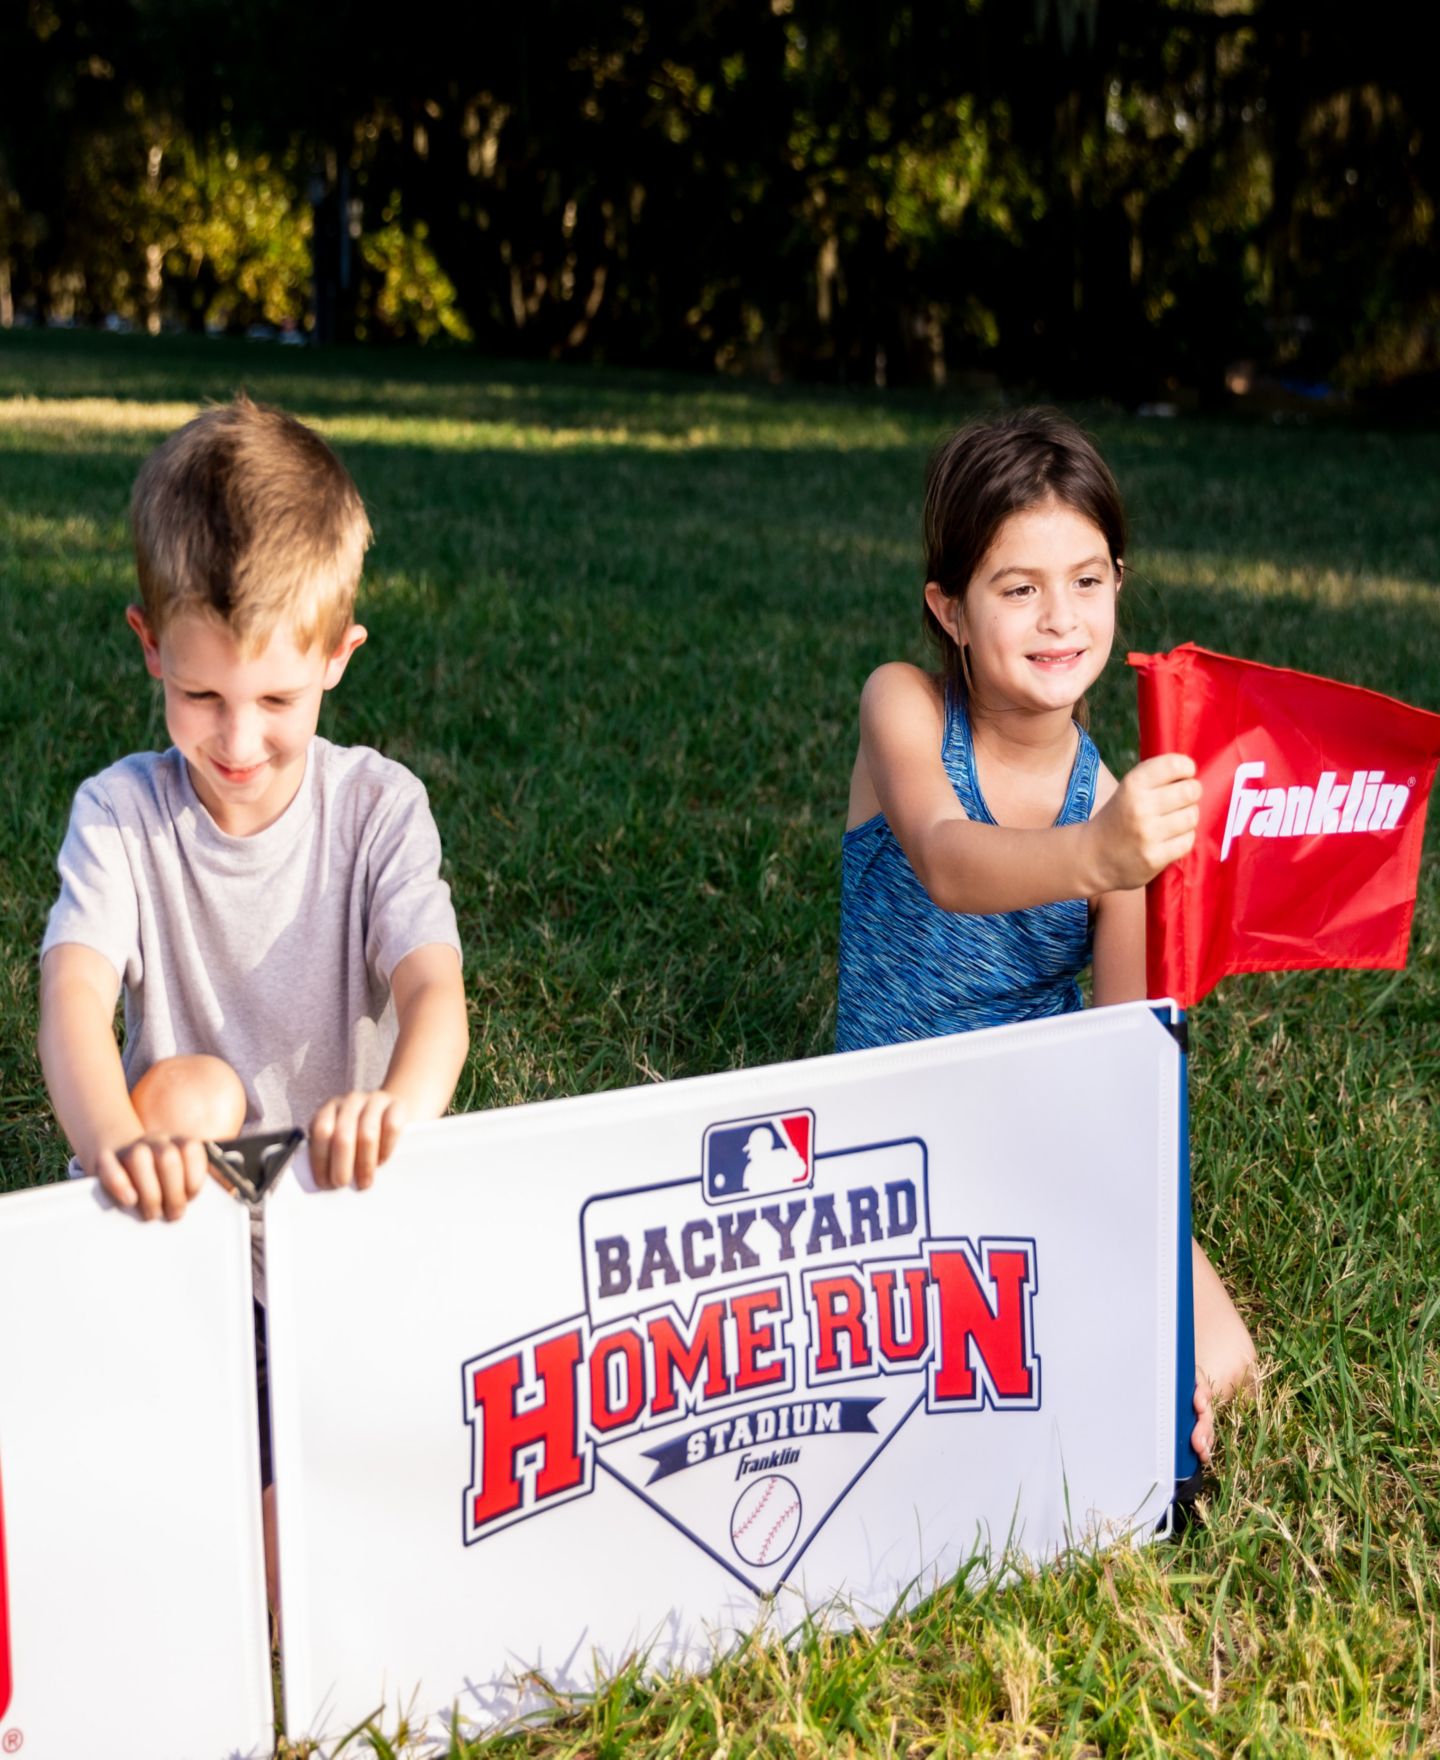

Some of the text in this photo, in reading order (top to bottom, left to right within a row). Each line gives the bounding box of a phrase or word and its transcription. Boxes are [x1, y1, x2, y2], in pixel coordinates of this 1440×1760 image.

[594, 1178, 918, 1299] BACKYARD
[472, 1248, 1031, 1530] HOME RUN
[686, 1401, 842, 1465] STADIUM
